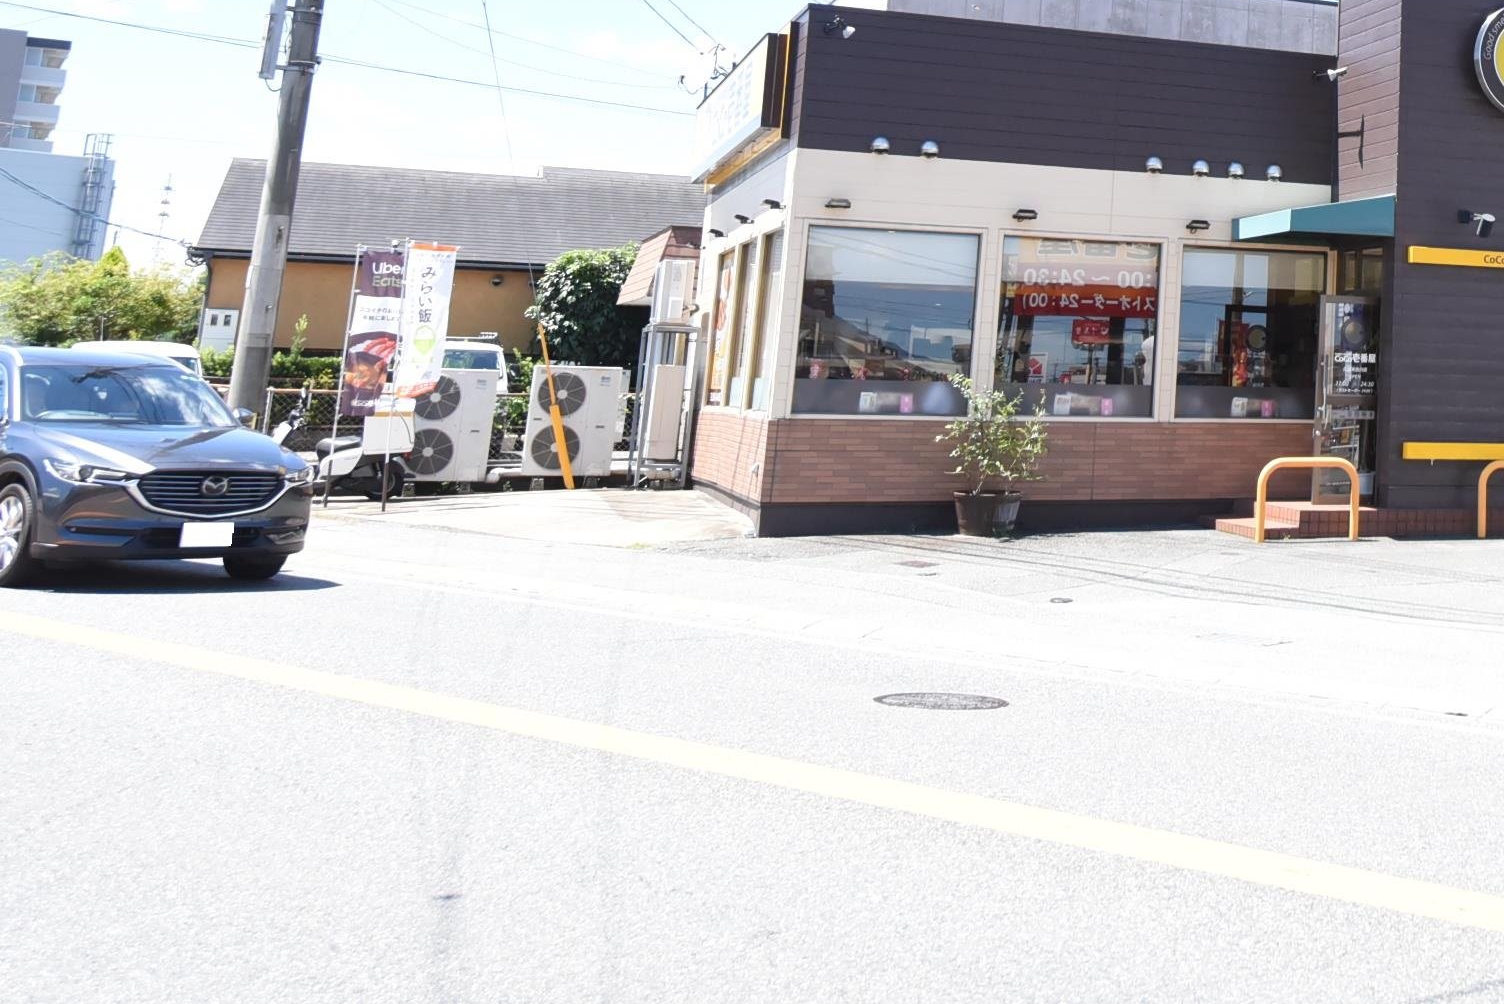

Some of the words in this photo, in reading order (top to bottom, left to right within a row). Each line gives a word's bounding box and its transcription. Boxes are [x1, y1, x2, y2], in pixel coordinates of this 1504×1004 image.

[1483, 32, 1495, 61] Good
[418, 265, 437, 324] みらい飯
